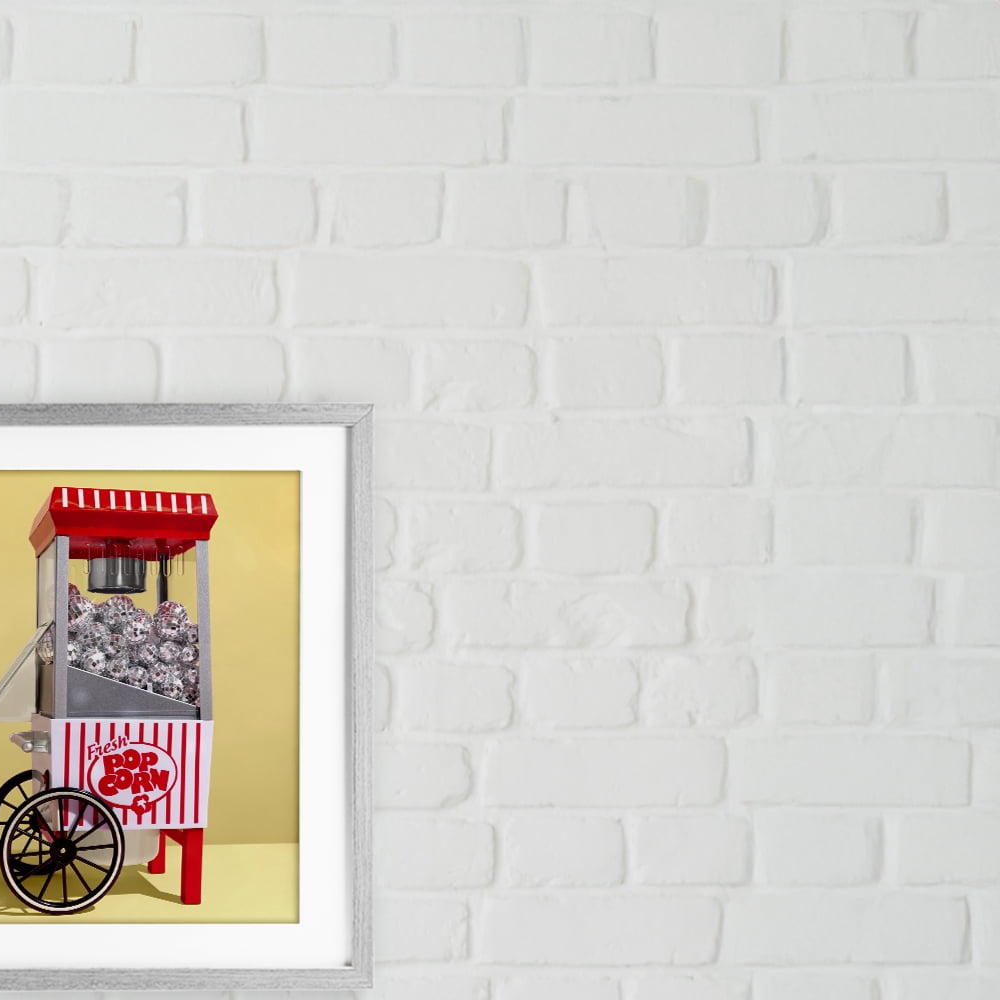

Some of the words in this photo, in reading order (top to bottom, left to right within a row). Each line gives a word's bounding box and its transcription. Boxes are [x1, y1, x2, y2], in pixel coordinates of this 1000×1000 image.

[88, 736, 128, 760] Fresh
[103, 749, 158, 775] POP
[98, 768, 169, 796] CORN
